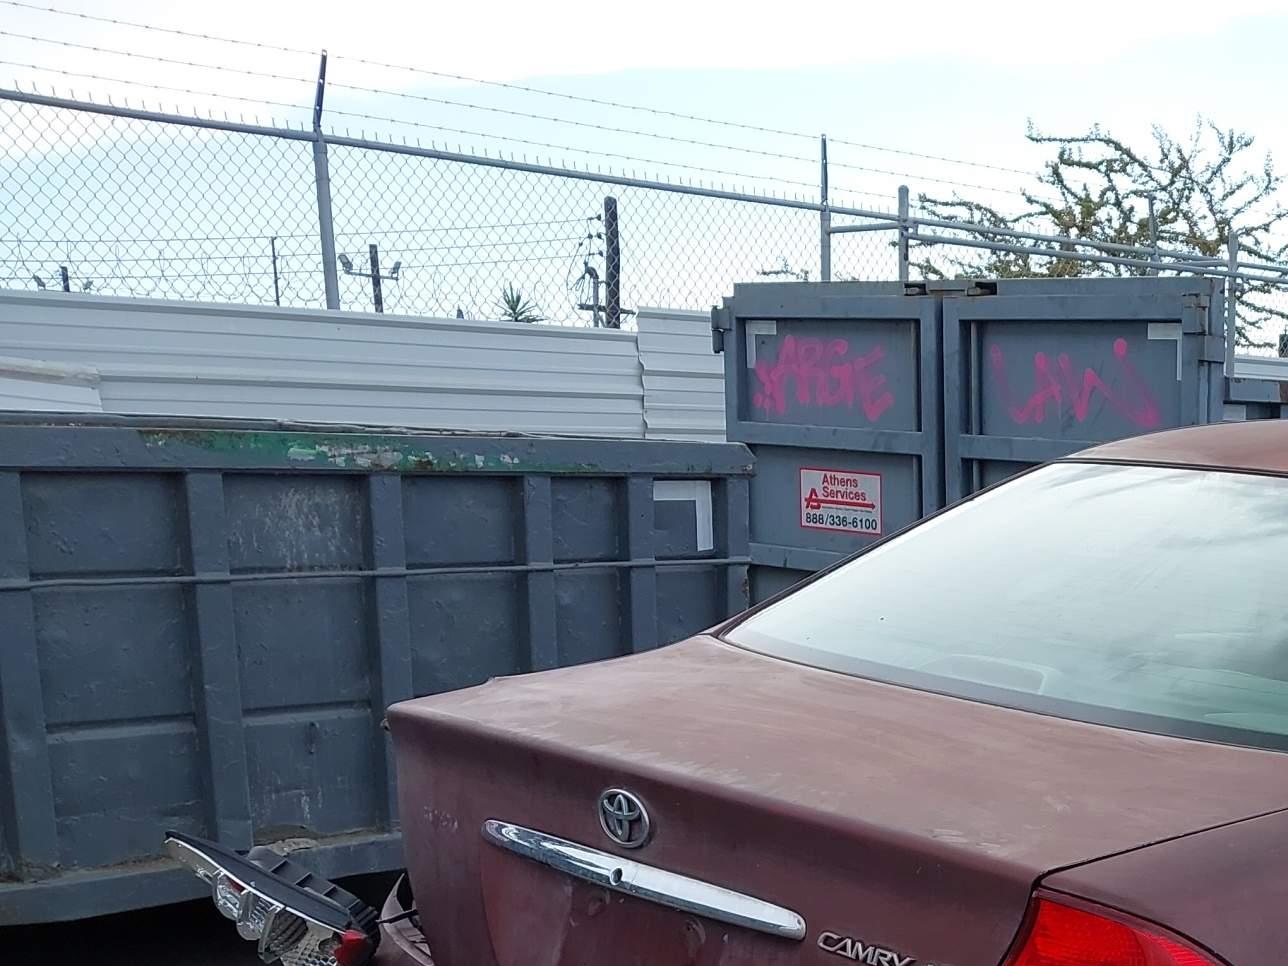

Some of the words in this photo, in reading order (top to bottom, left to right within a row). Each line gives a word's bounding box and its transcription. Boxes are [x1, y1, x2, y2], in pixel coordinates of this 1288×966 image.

[822, 473, 858, 488] Athens
[822, 486, 867, 502] Services
[805, 512, 878, 531] 888/336-6100
